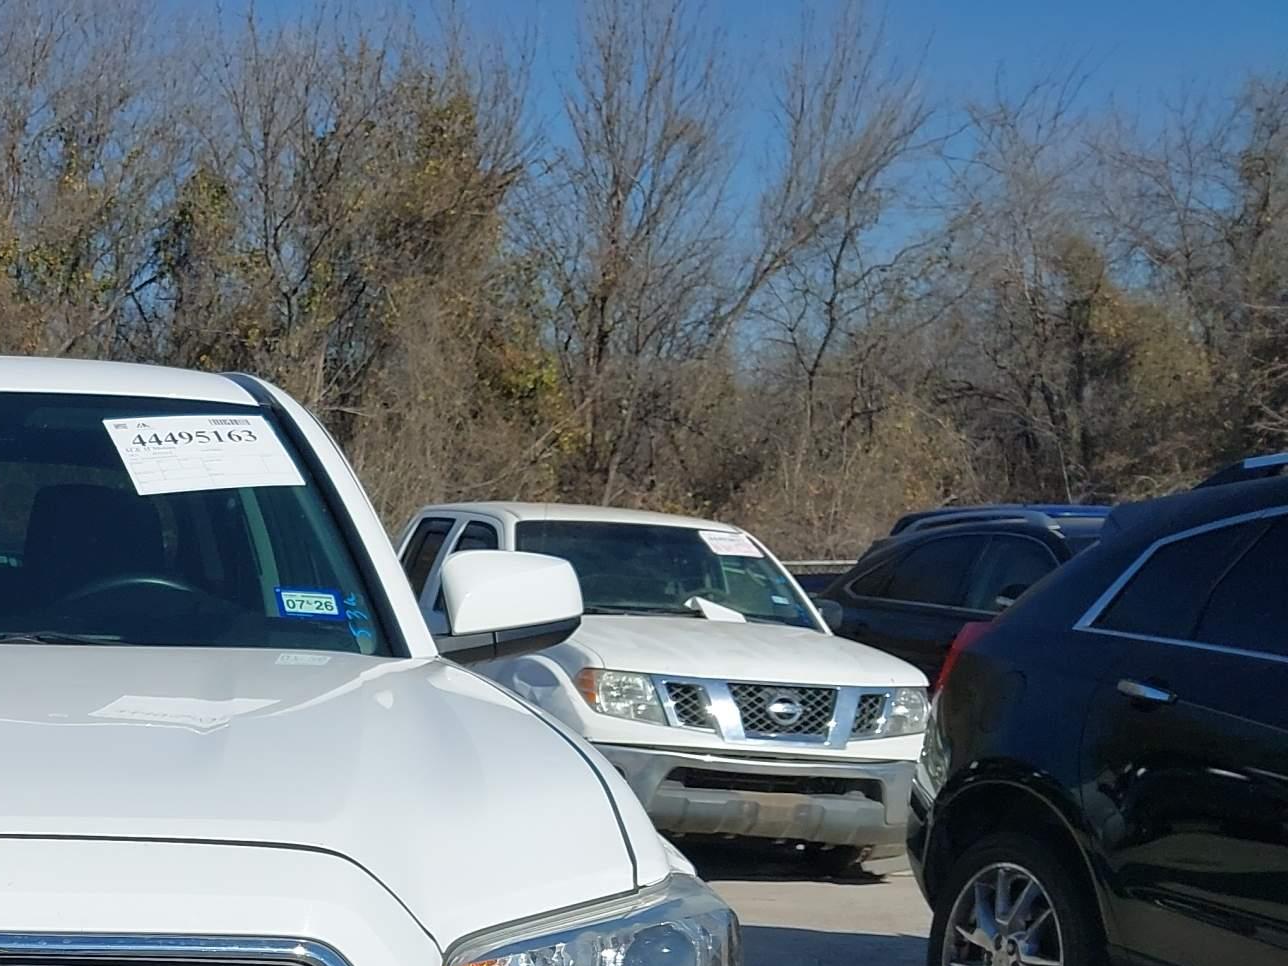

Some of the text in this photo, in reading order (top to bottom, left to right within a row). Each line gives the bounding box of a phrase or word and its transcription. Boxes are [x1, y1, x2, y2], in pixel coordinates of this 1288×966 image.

[132, 429, 258, 447] 44495163
[286, 598, 335, 612] 07 26
